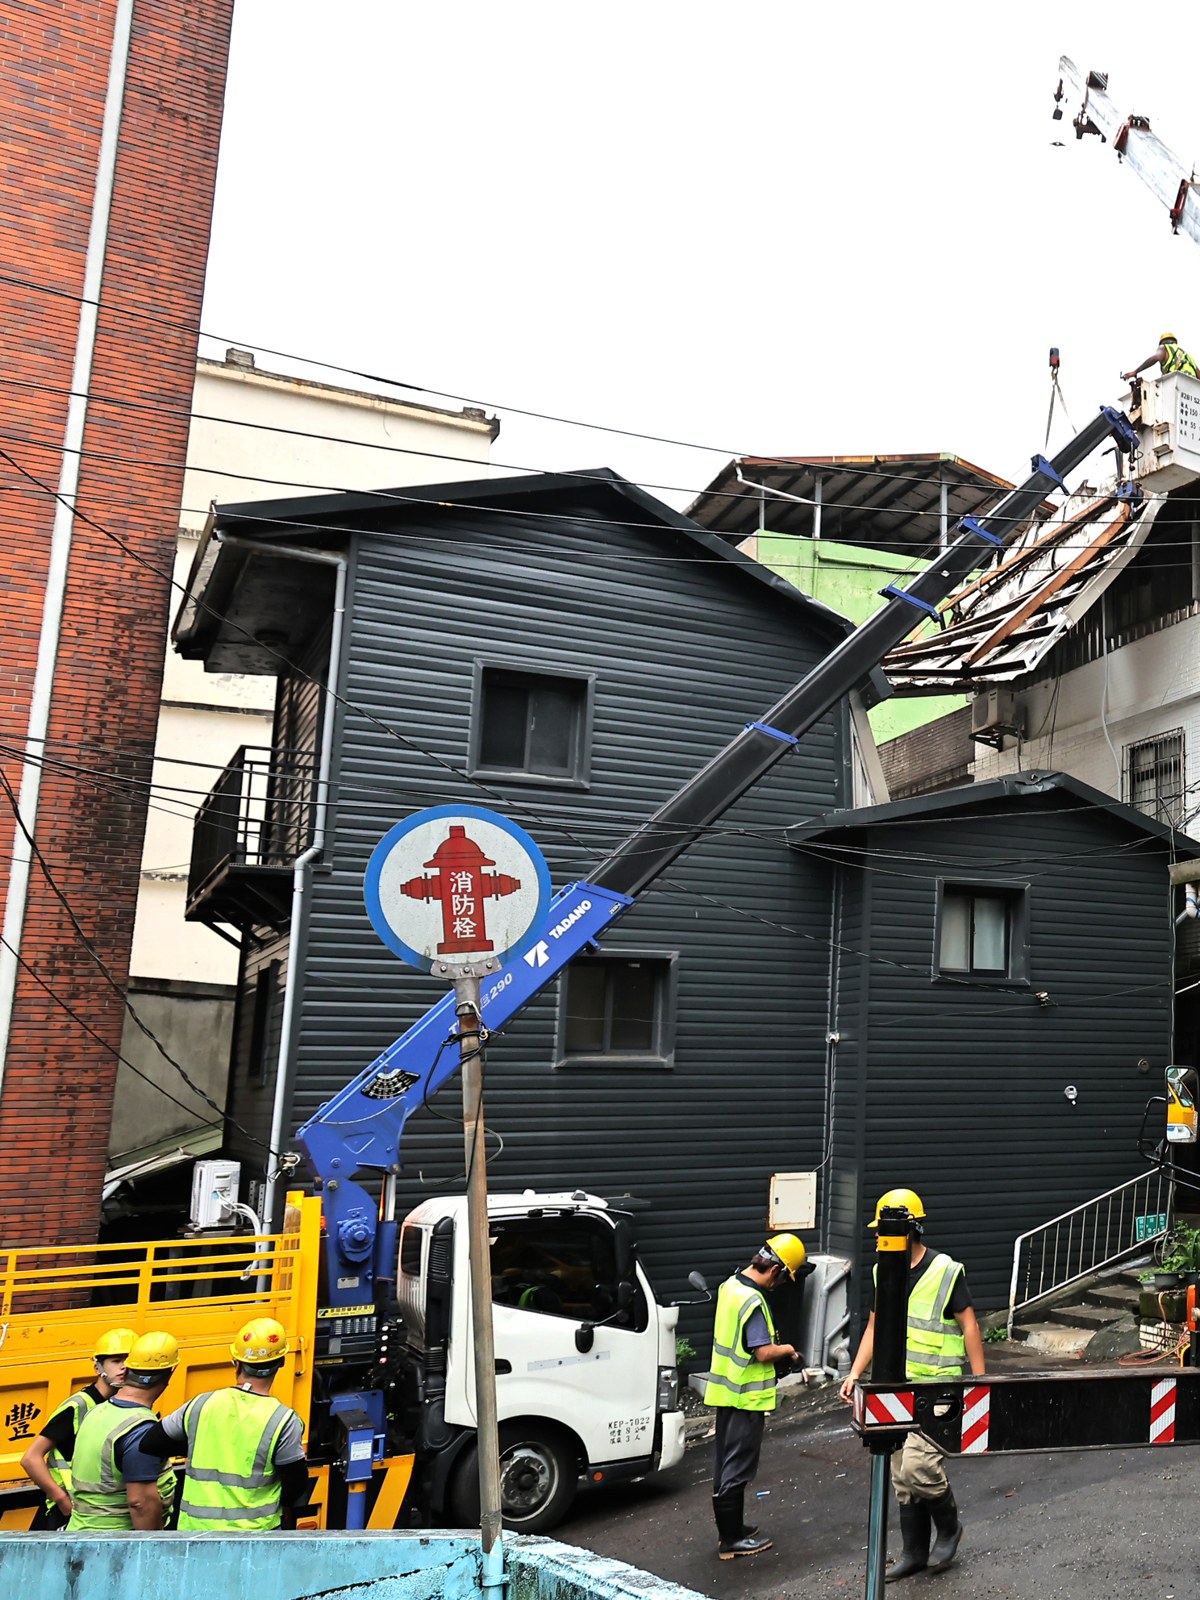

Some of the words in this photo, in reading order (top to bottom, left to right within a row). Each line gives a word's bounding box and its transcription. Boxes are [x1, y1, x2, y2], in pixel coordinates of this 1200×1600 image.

[450, 871, 477, 939] 消防栓
[549, 900, 592, 939] TADANO
[5, 1402, 41, 1441] 豐
[608, 1417, 650, 1429] KEP-7022
